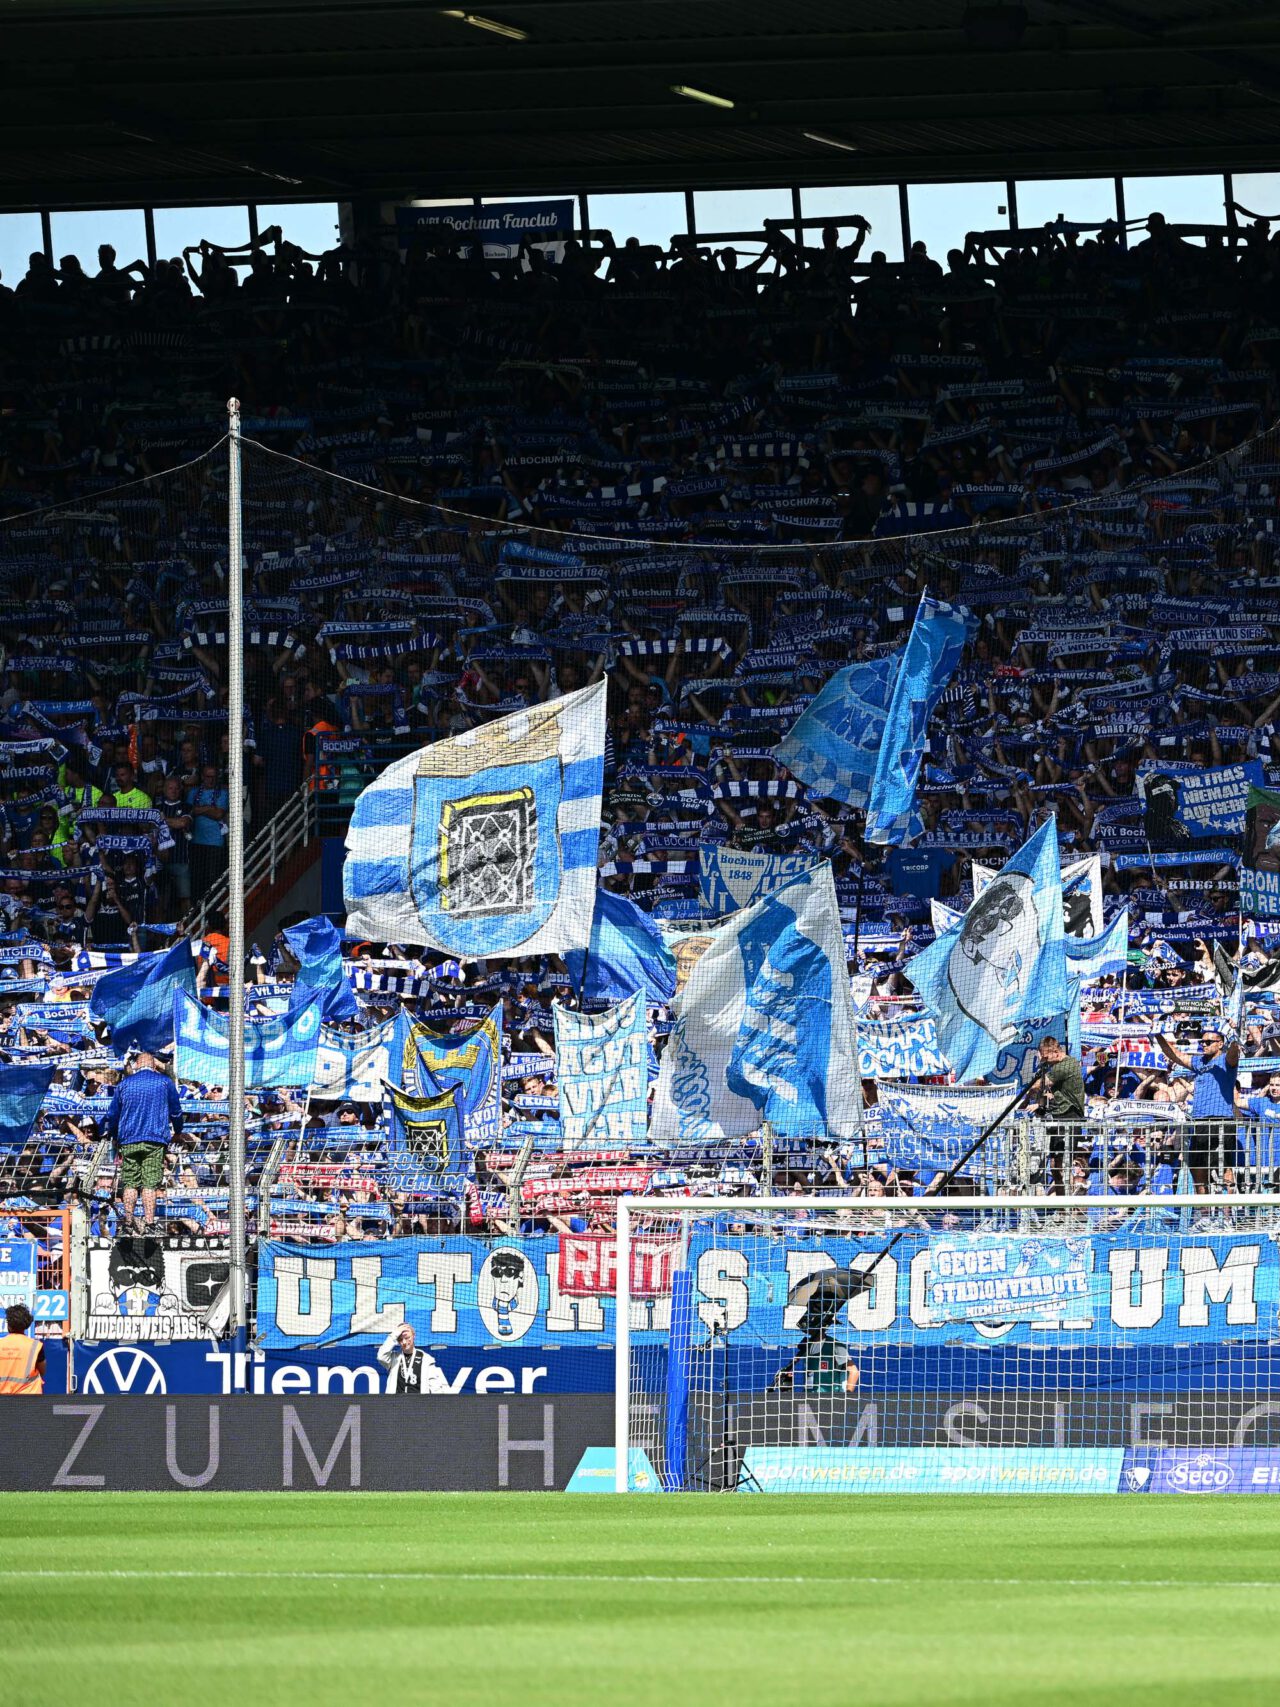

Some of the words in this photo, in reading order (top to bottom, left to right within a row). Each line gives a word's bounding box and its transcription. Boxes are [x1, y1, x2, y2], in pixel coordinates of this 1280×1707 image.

[503, 212, 558, 229] Fanclub
[78, 634, 123, 646] Bochum
[750, 654, 797, 668] BOCHUM
[322, 740, 361, 752] BOCHUM
[1184, 765, 1245, 790] ULTRAS
[1182, 781, 1251, 805] NIEMALS
[720, 854, 765, 867] Bochum
[1119, 853, 1139, 865] Der
[1193, 850, 1224, 863] wieder
[728, 869, 753, 881] 1848
[902, 864, 930, 872] TRICORP
[1168, 879, 1213, 891] KRIEG
[1240, 870, 1279, 892] FROM
[1240, 893, 1254, 908] TO
[1151, 930, 1191, 941] Bochum,
[1209, 930, 1229, 939] steh
[556, 1033, 646, 1077] ACHT
[944, 1089, 986, 1099] BOCHUMER
[1136, 1103, 1166, 1112] Bochum
[937, 1248, 1007, 1276] GEGEN
[931, 1270, 1088, 1304] STADIONVERBOTE
[37, 1294, 66, 1316] 22
[52, 1404, 362, 1487] ZUM
[754, 1461, 919, 1485] sportwetten.de
[941, 1461, 1108, 1486] sportwetten.de
[1172, 1466, 1229, 1487] Seco
